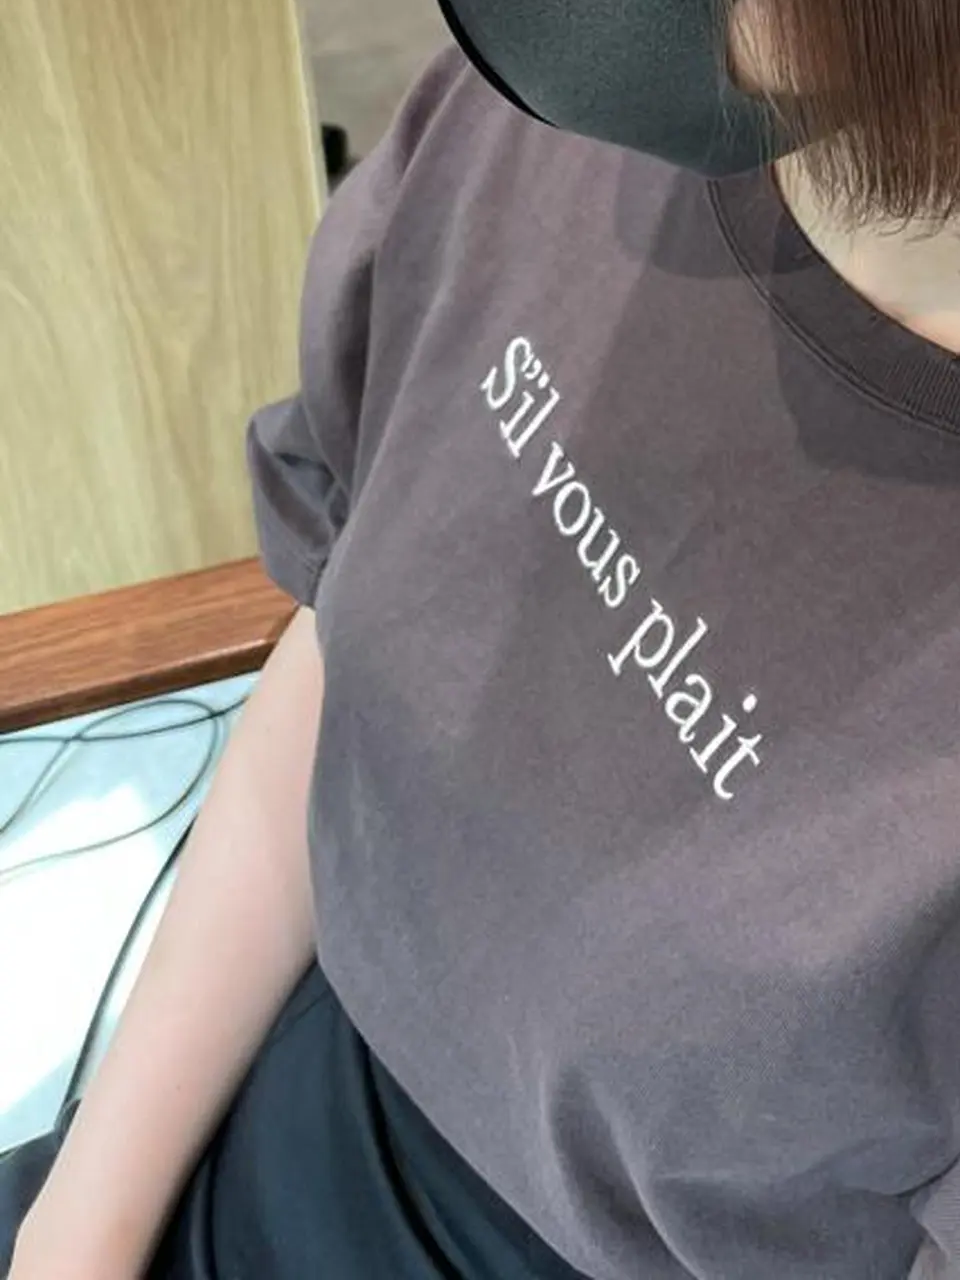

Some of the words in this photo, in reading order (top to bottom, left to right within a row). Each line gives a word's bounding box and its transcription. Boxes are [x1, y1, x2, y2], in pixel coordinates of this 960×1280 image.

[479, 335, 561, 458] S'il
[531, 441, 641, 609] vous
[607, 598, 763, 801] plait
